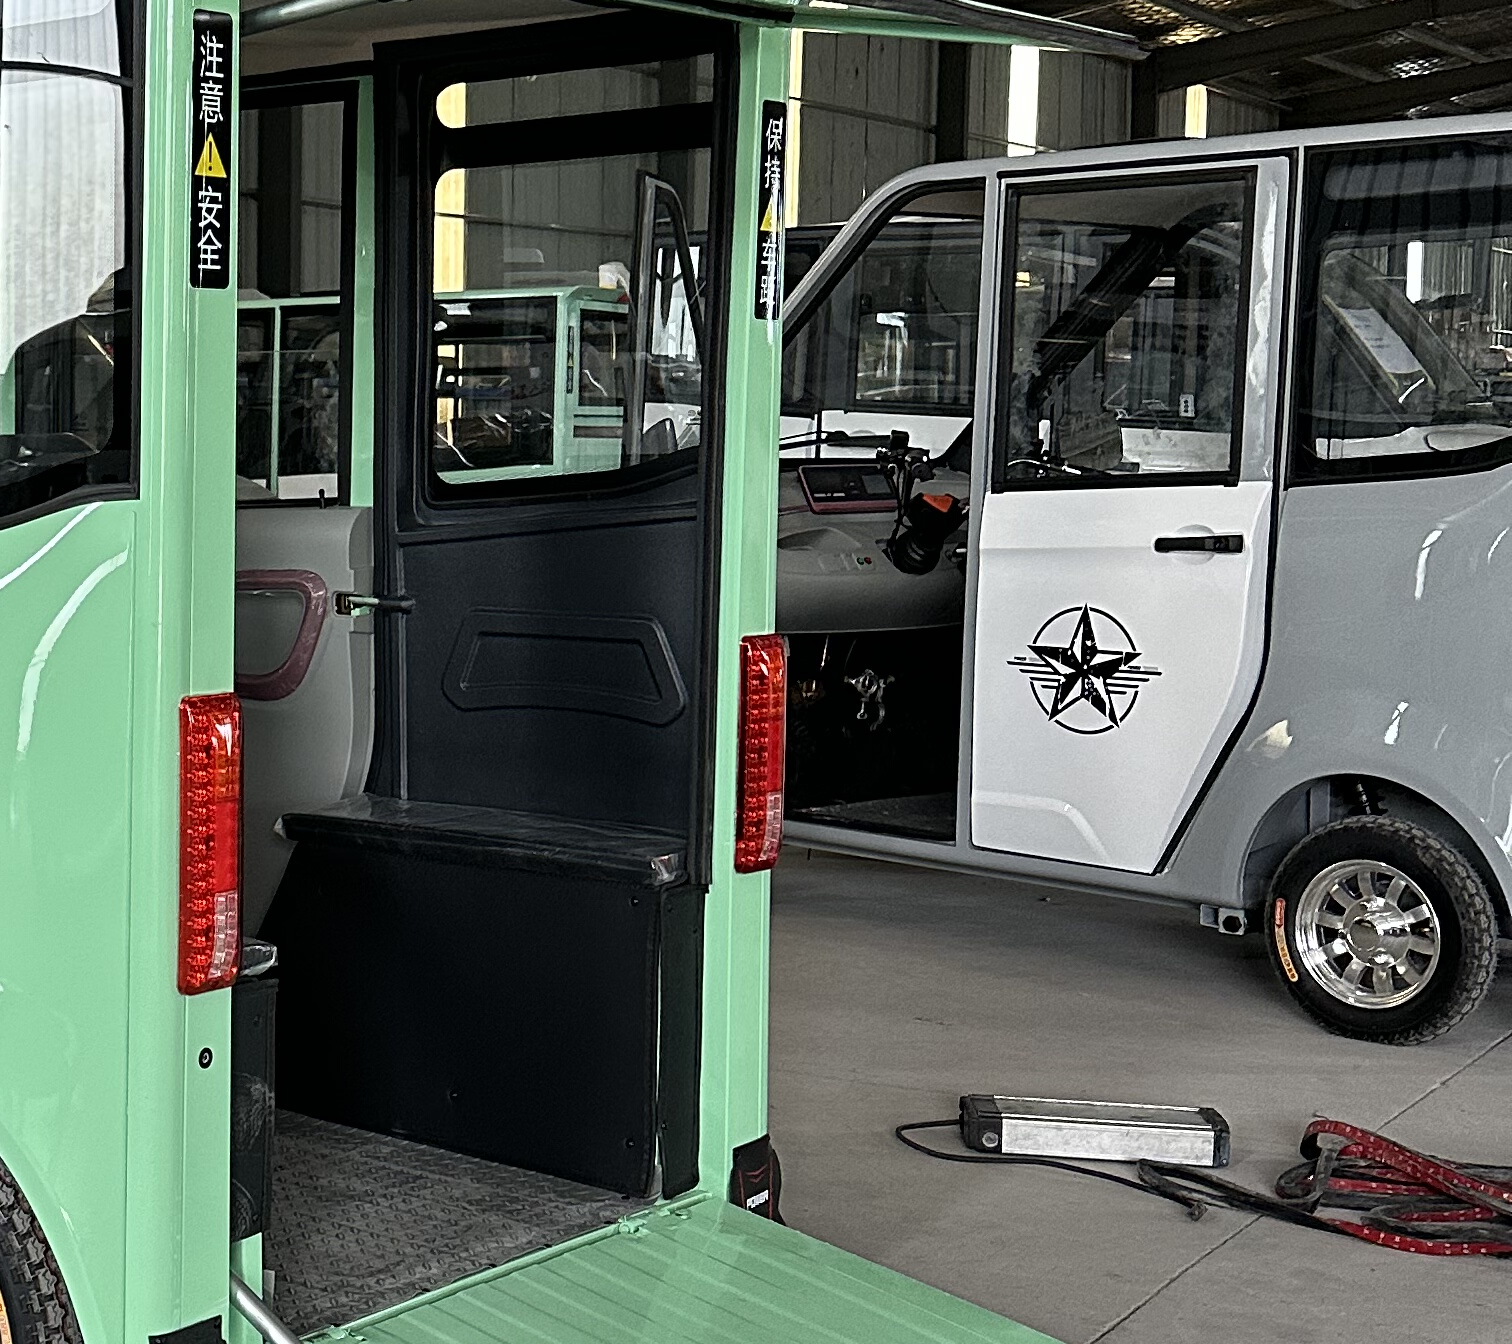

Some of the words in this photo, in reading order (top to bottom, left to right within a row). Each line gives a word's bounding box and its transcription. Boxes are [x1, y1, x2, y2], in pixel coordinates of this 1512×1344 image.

[199, 30, 225, 124] 注意
[764, 116, 784, 190] 保持
[197, 185, 223, 270] 安全
